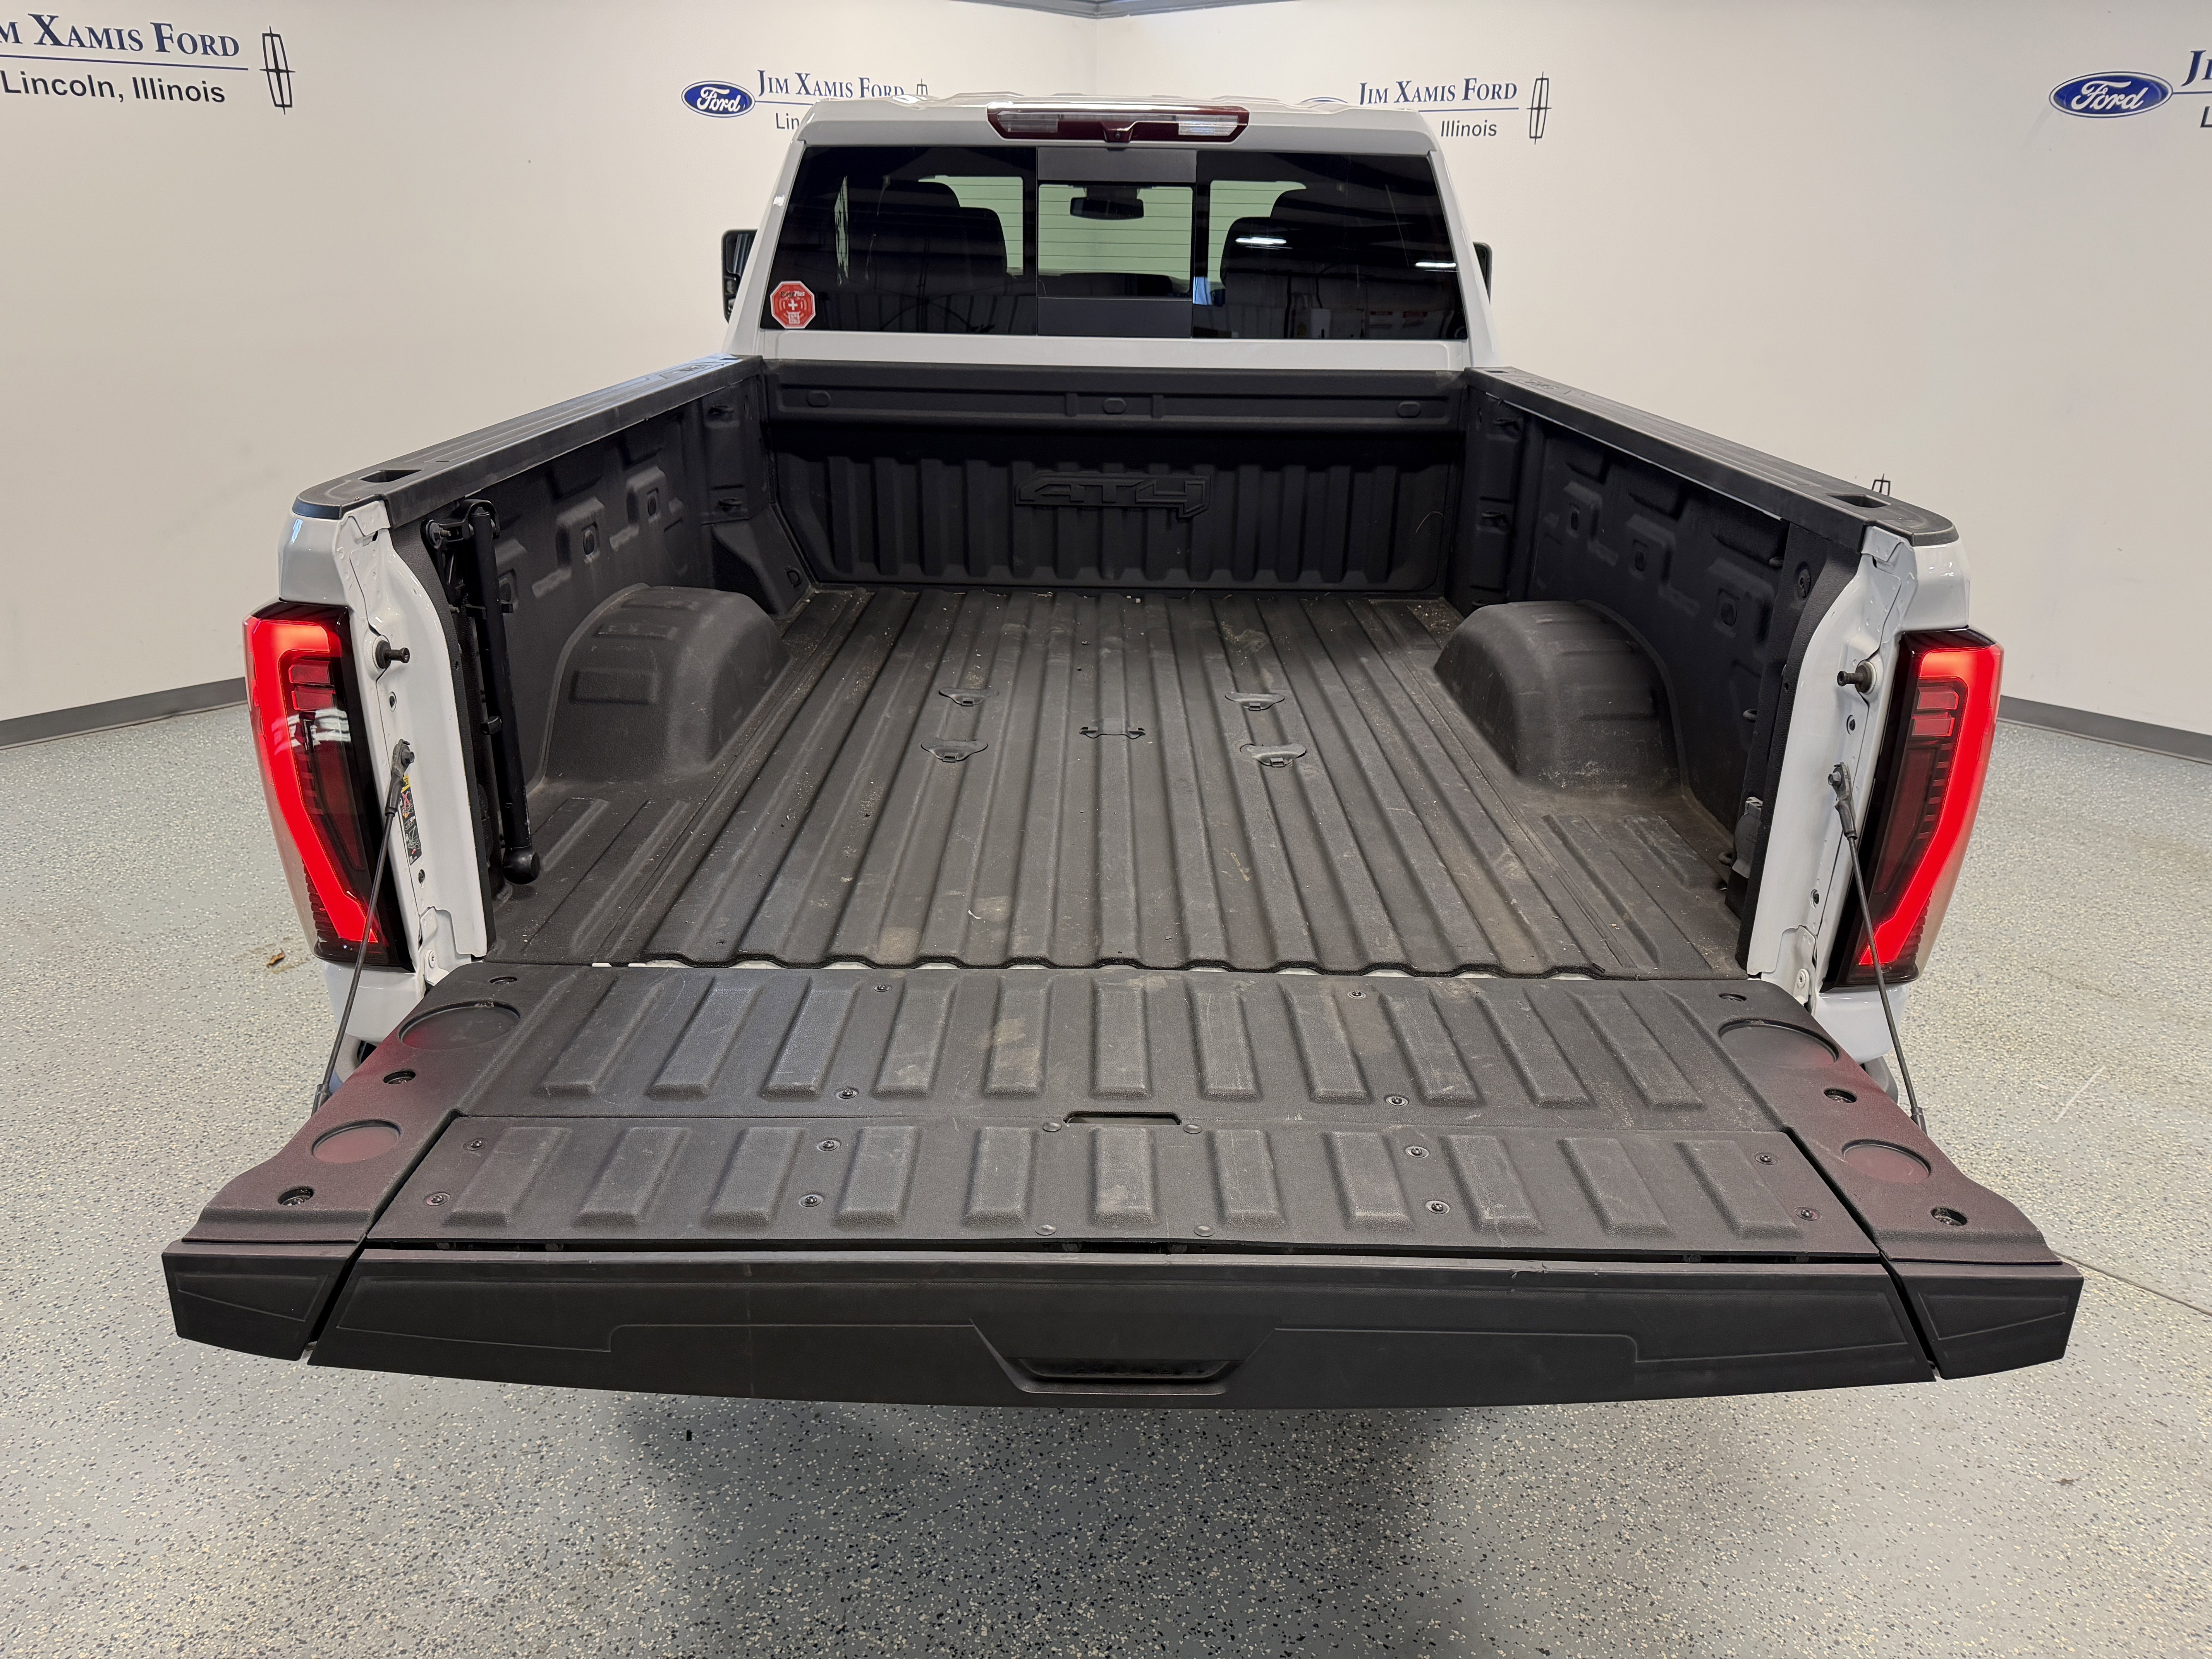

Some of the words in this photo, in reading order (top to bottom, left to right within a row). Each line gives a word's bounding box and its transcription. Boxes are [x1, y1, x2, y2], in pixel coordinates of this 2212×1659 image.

[27, 14, 143, 52] XAMIS
[150, 22, 239, 57] FORD
[0, 70, 124, 103] Lincoln,
[132, 76, 225, 103] Illinois
[757, 69, 790, 97] JIM
[795, 72, 853, 98] XAMIS
[1359, 82, 1389, 105] JIM
[1394, 81, 1456, 103] XAMIS
[1462, 77, 1517, 101] FORD
[2071, 81, 2148, 110] Ford
[697, 86, 742, 112] Ford
[1441, 120, 1497, 137] Illinois
